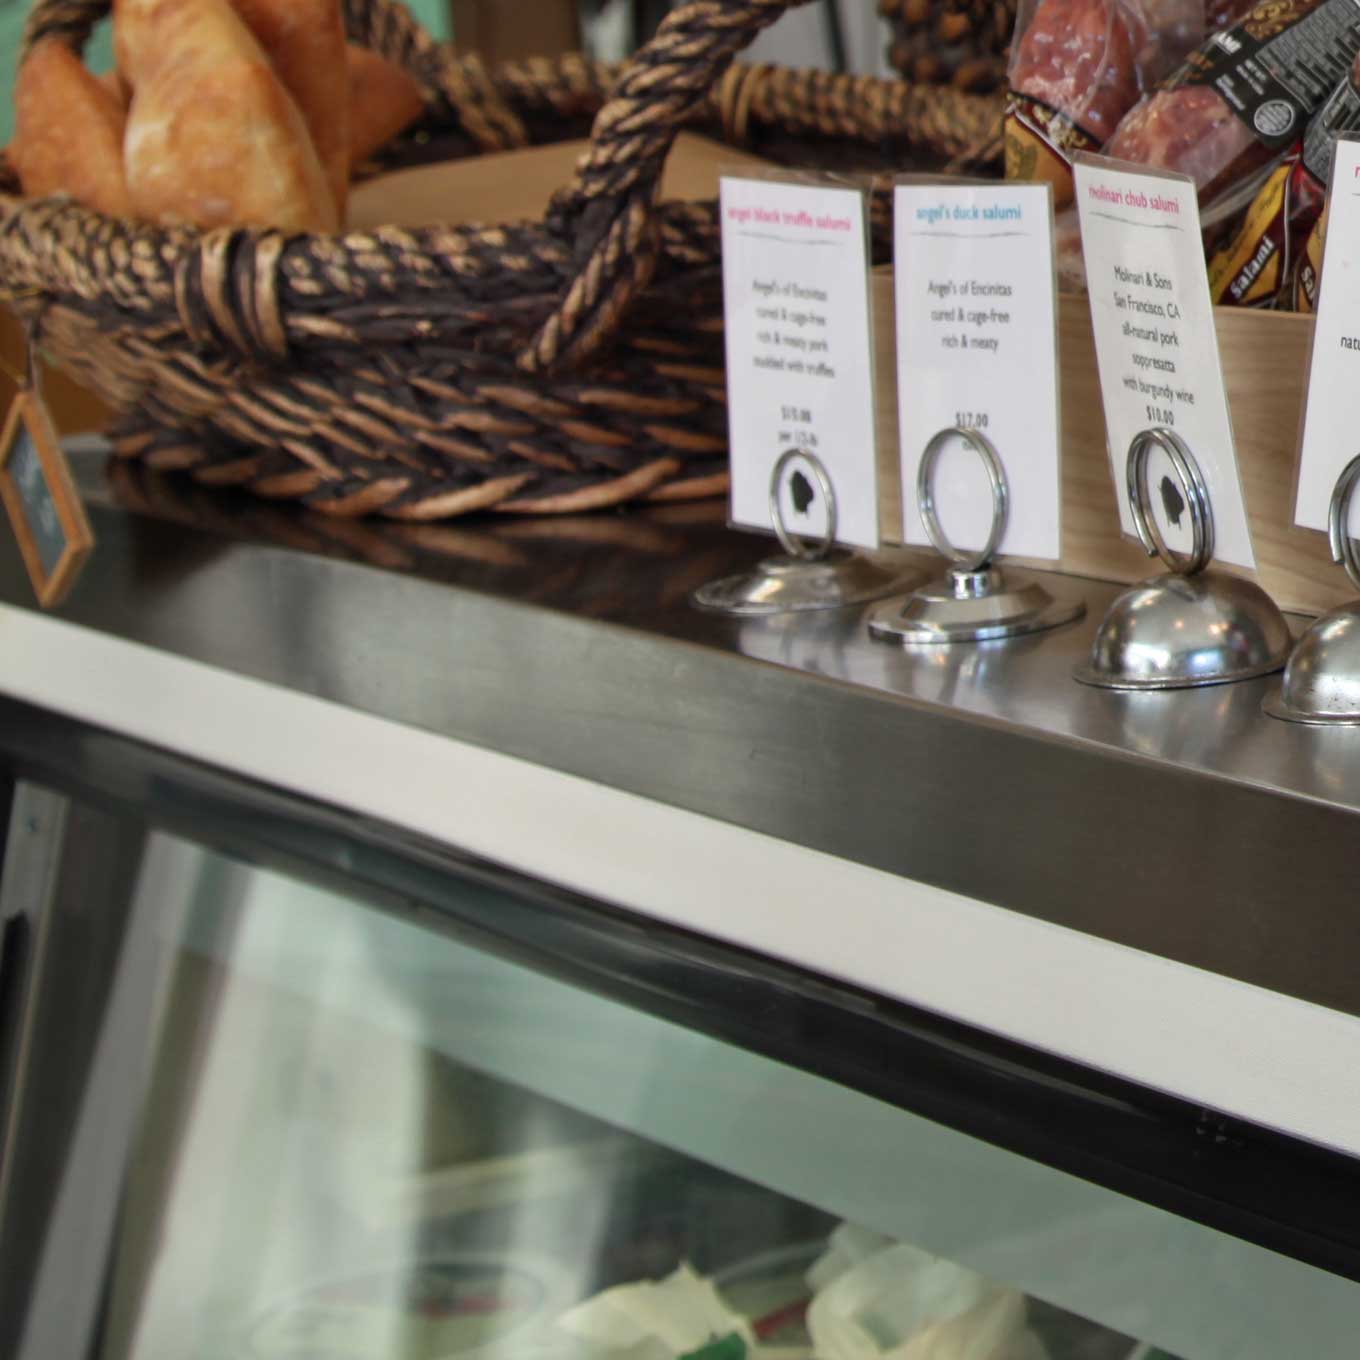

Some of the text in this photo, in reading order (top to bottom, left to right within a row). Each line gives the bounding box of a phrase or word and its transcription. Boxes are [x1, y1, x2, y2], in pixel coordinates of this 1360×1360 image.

[1089, 184, 1180, 214] molinari chub salumi
[917, 205, 1021, 225] angel's duck salumi
[1114, 265, 1173, 291] Molinari & Sons
[1230, 234, 1275, 299] salami
[1113, 291, 1181, 320] San Francisco, CA
[1146, 406, 1175, 426] $10.00
